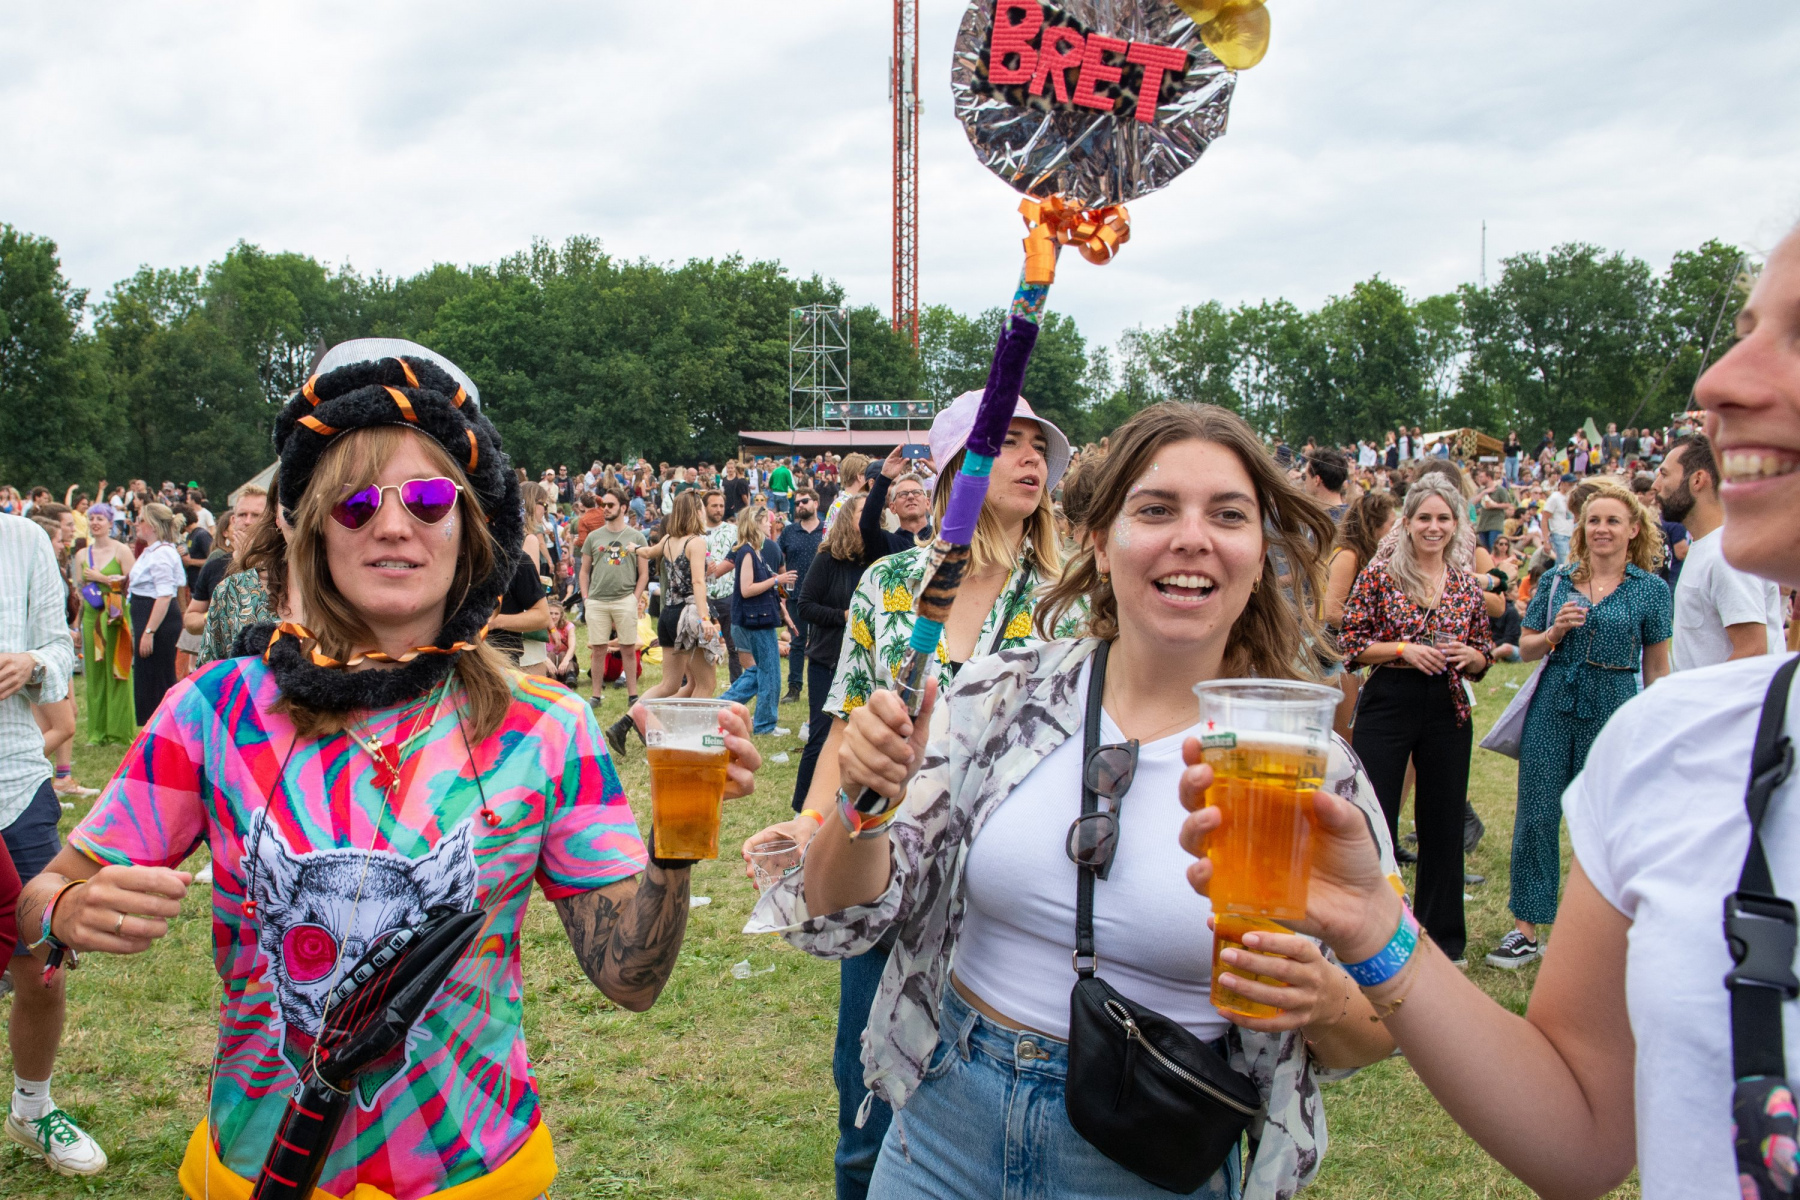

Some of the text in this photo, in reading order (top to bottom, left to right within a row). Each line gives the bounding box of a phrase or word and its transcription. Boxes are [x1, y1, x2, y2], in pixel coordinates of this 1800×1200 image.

[989, 0, 1188, 123] BRET
[864, 404, 892, 416] BAR
[704, 735, 725, 746] Heine
